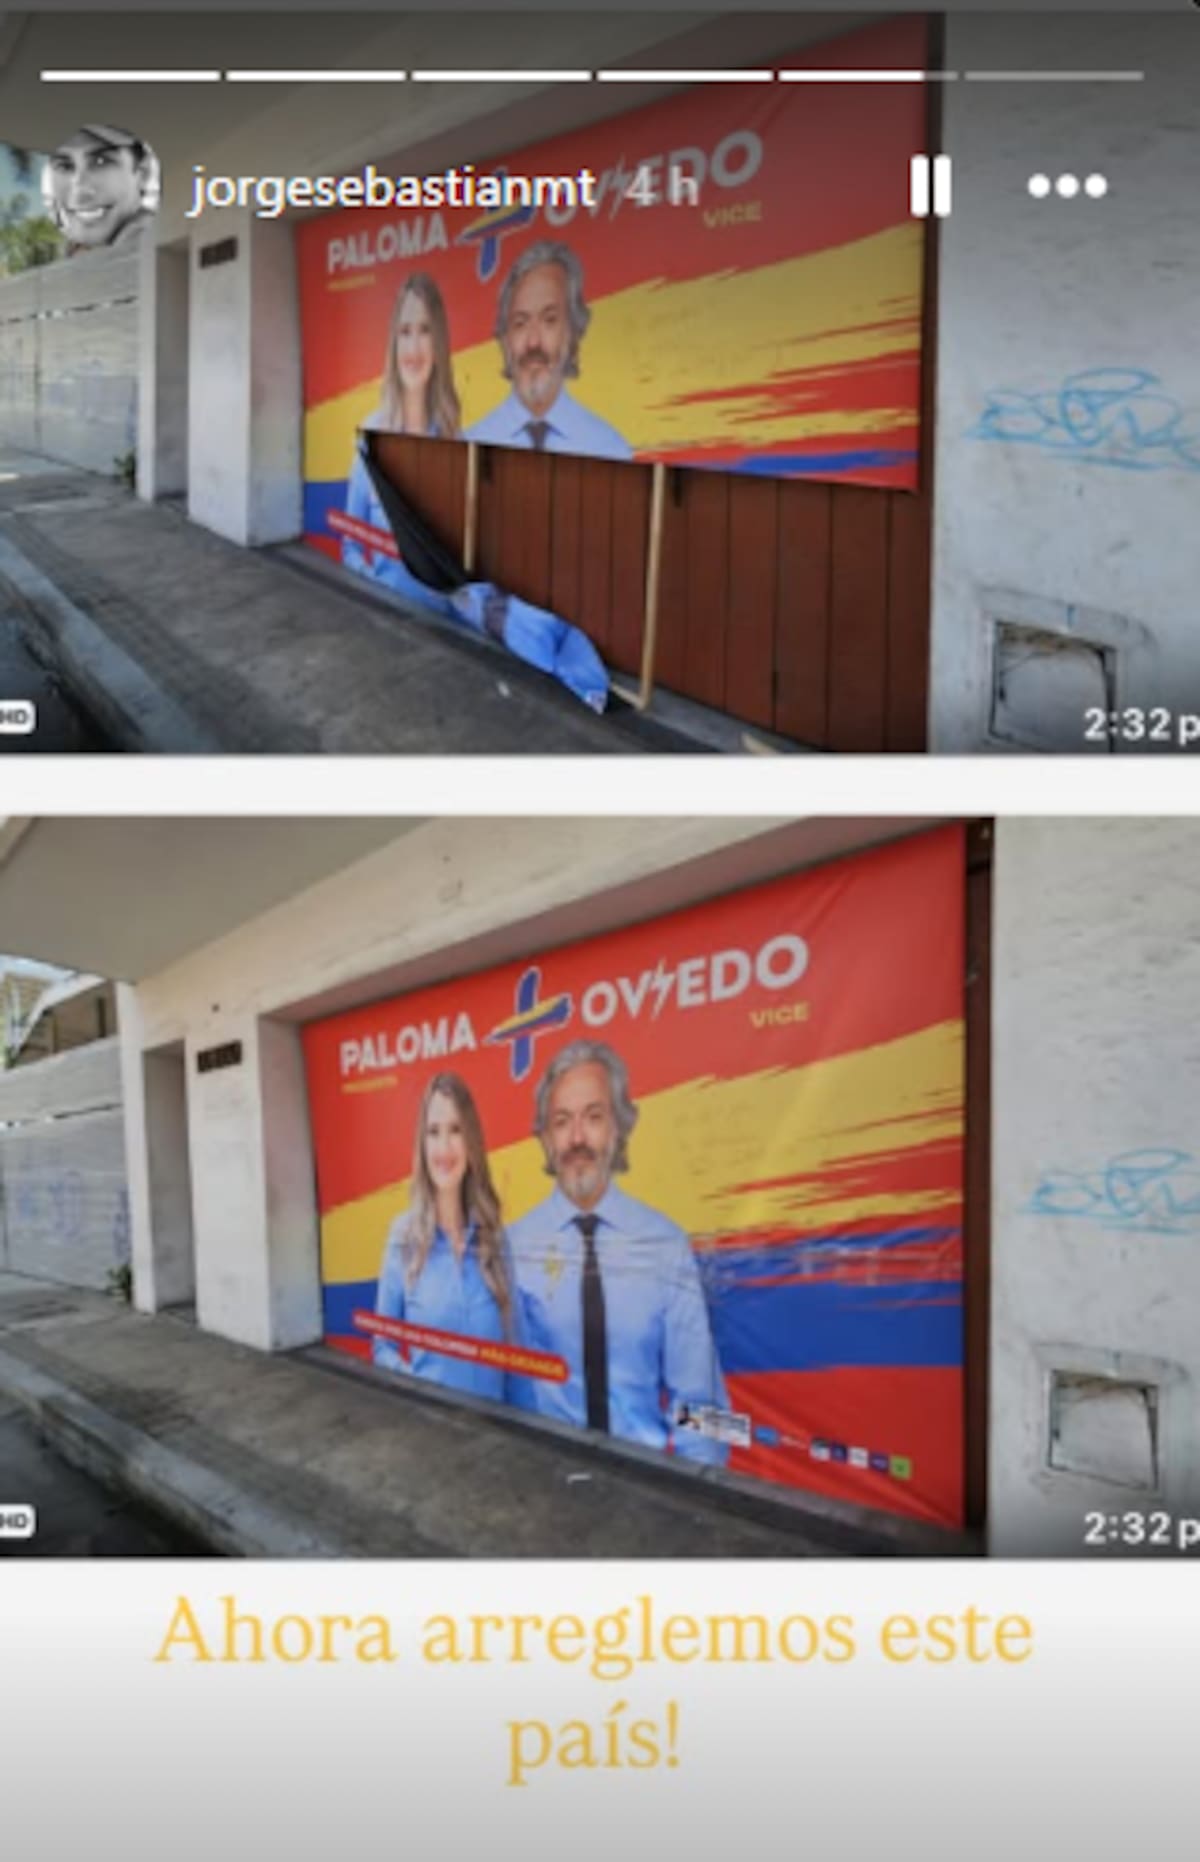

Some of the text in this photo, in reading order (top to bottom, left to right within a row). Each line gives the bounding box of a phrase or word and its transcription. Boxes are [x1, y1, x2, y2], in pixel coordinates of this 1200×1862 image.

[702, 201, 763, 229] VICE
[327, 212, 449, 274] PALOMA
[748, 1002, 810, 1029] VICE
[340, 1012, 476, 1076] PALOMA
